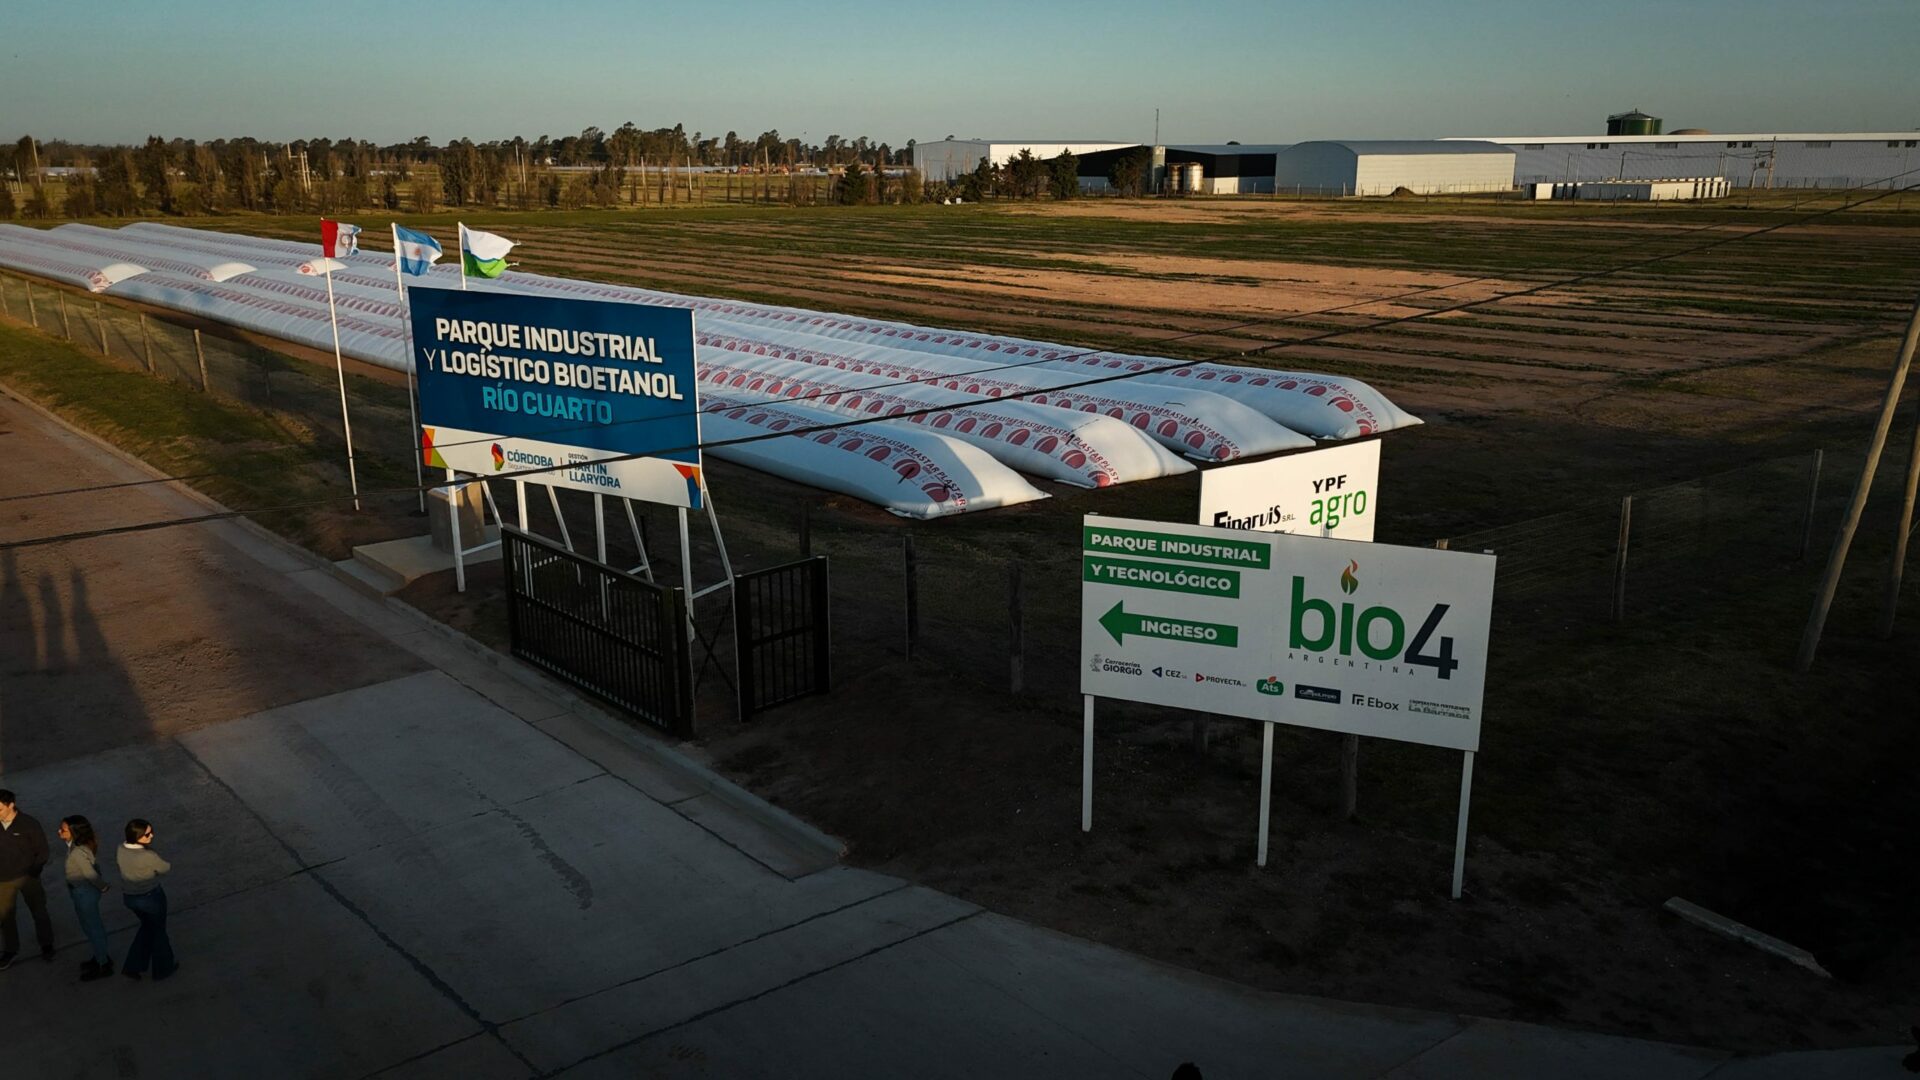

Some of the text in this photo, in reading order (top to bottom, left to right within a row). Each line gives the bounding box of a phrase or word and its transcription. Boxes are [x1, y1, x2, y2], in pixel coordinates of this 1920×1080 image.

[436, 318, 521, 351] PARQUE
[524, 326, 663, 363] INDUSTRIAL
[423, 347, 436, 371] Y
[441, 348, 550, 384] LOGÍSTICO
[554, 362, 683, 400] BIOETANOL
[482, 382, 612, 425] RÍO CUARTO
[1162, 409, 1193, 424] PLASTAR
[507, 449, 555, 468] CÓRDOBA
[908, 446, 939, 473] PLASTAR
[1073, 437, 1103, 462] PLASTAR
[569, 471, 621, 489] LLARYORA
[1312, 474, 1347, 494] YPF
[1309, 490, 1367, 530] agro
[1091, 533, 1262, 562] PARQUE INDUSTRIAL
[1091, 564, 1232, 591] Y TECNOLÓGICO
[1141, 619, 1218, 641] INGRESO
[1289, 575, 1459, 681] bio4
[1103, 664, 1143, 676] GIORGIO
[1165, 669, 1181, 679] CEZ
[1288, 652, 1415, 676] ARGENTINA
[1206, 675, 1242, 687] PROYECTA
[1262, 682, 1279, 693] Ats
[1367, 696, 1399, 711] Ebox
